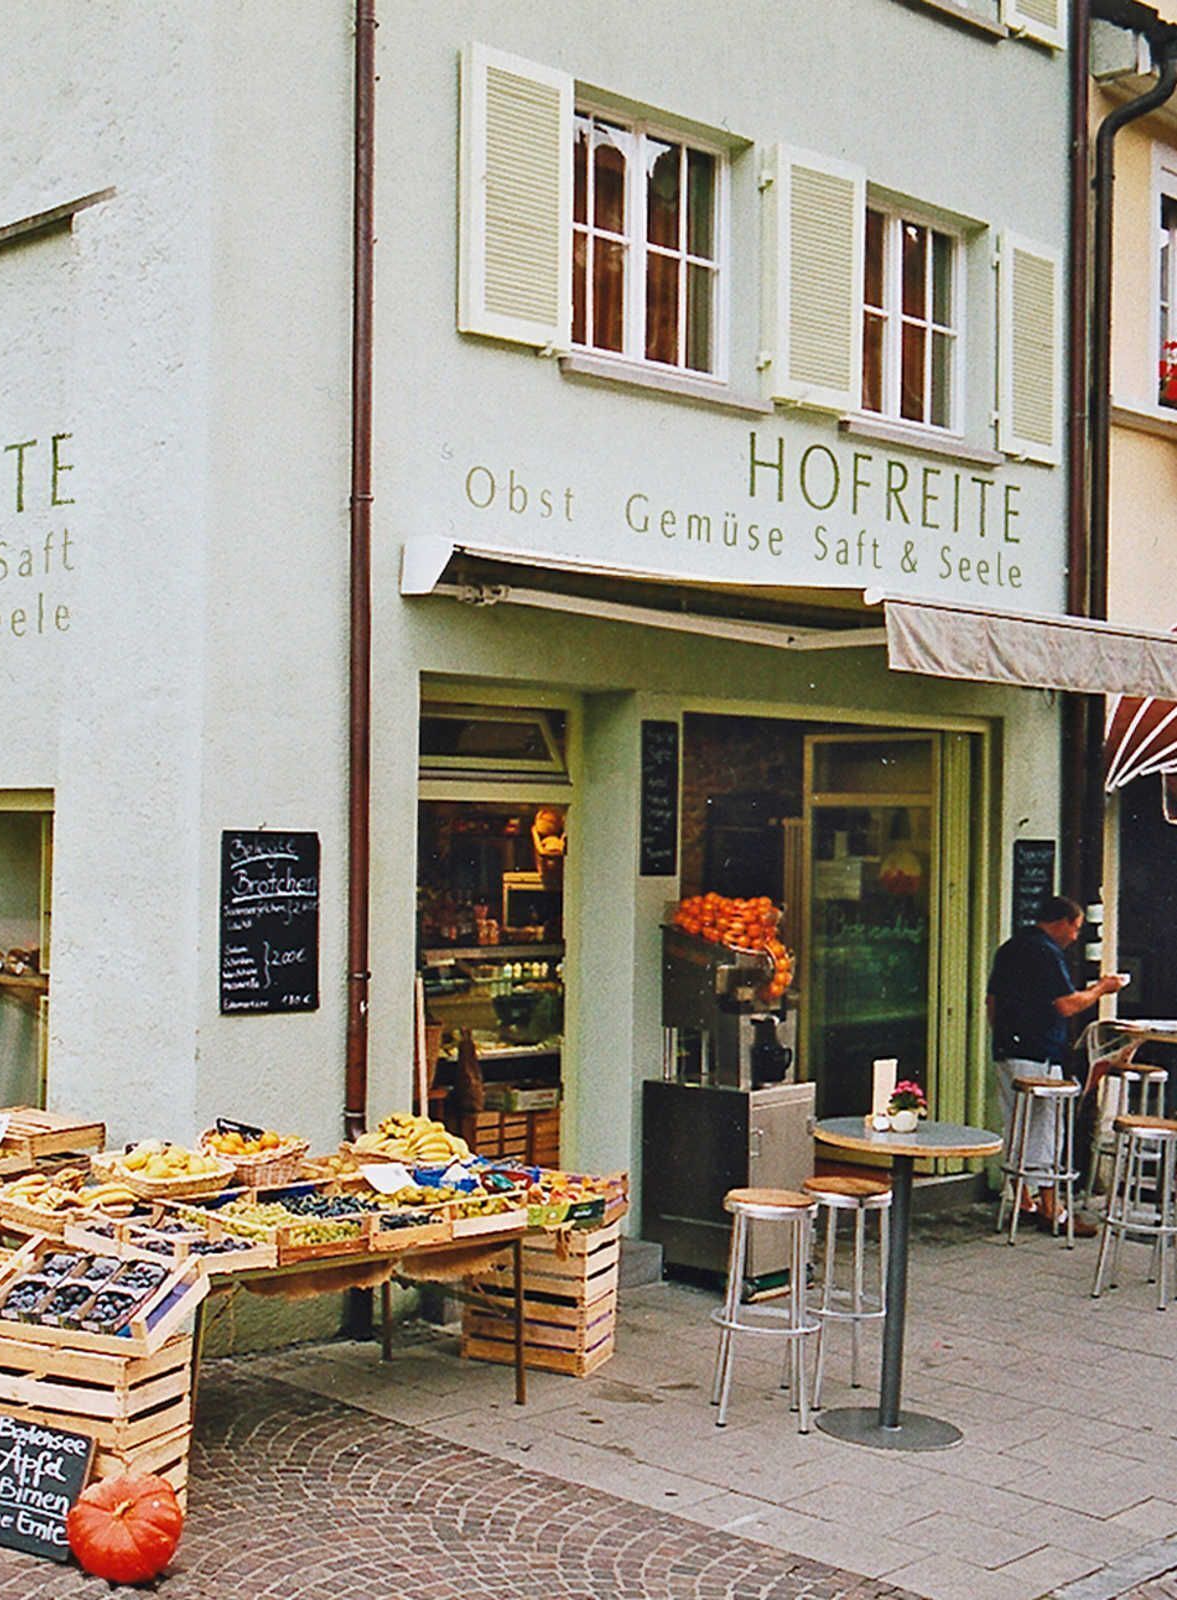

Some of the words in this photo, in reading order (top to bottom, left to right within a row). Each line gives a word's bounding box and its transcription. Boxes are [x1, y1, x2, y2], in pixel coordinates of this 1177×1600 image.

[465, 465, 575, 522] Obst
[624, 493, 785, 557] Gemüse
[814, 525, 883, 570] Saft
[900, 540, 919, 574] &
[939, 545, 1024, 588] Seele
[748, 431, 1022, 544] HOFREITE
